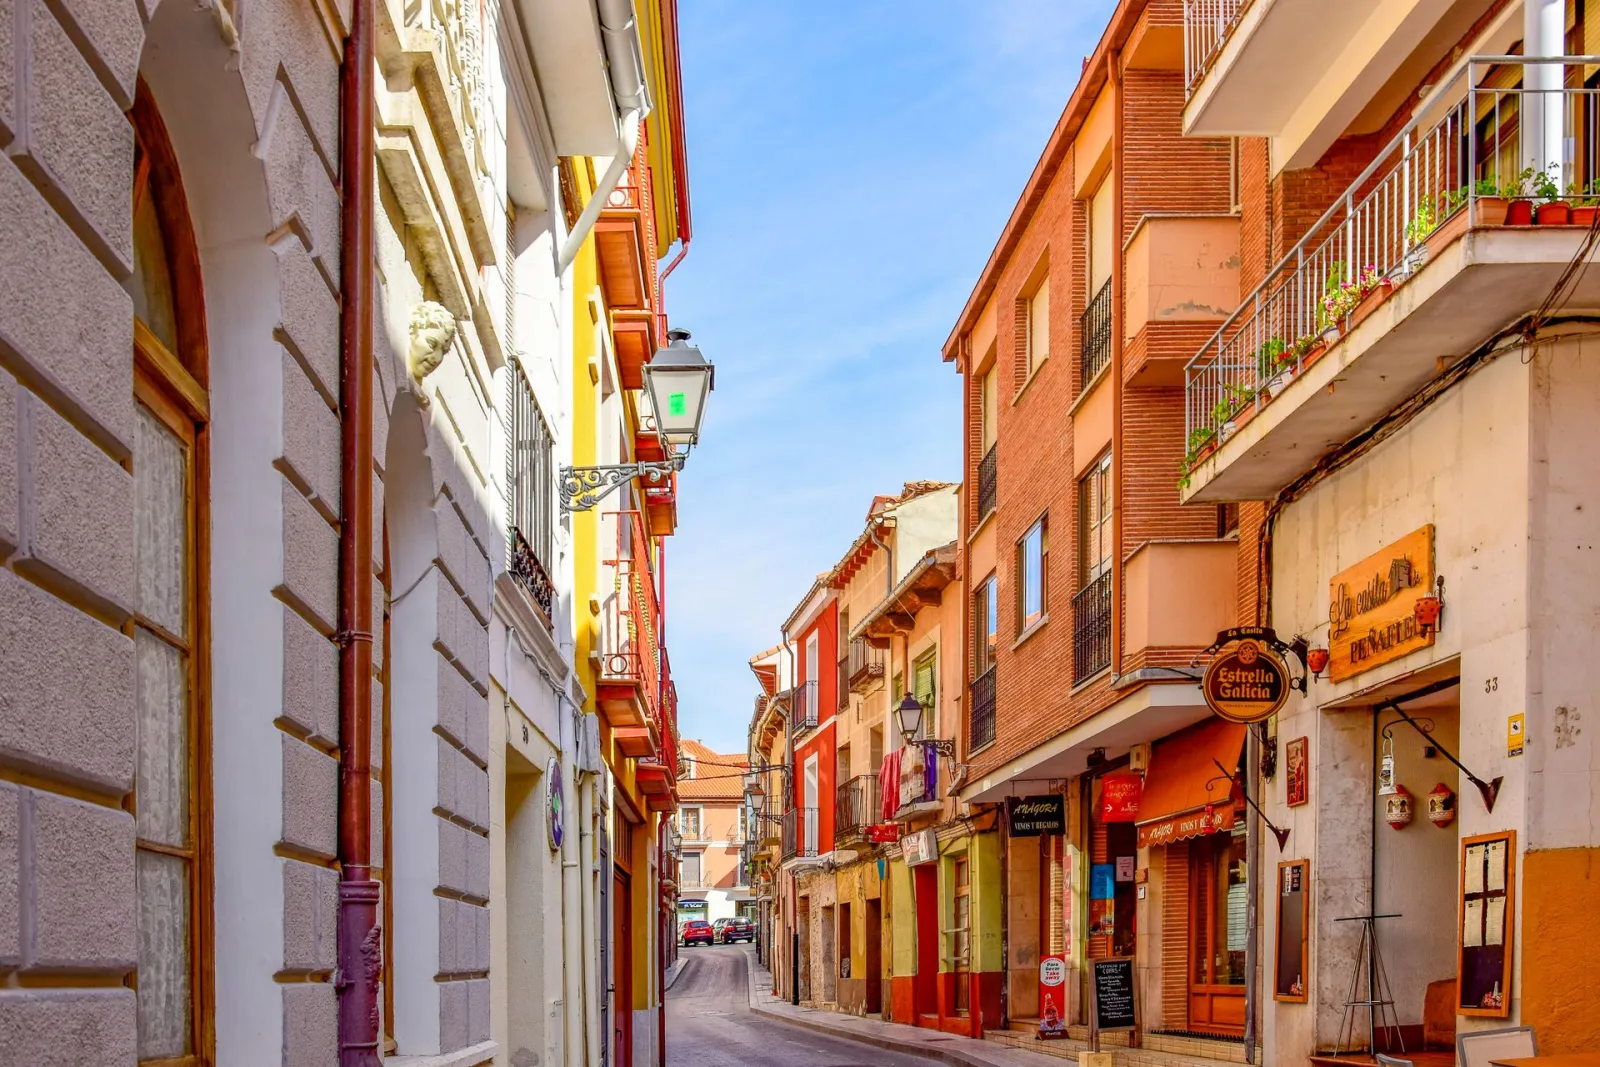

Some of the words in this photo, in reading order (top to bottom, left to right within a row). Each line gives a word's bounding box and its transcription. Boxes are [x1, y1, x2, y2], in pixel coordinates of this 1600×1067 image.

[1329, 583, 1352, 640] La
[1356, 572, 1389, 615] casita
[1227, 629, 1237, 637] La
[1241, 627, 1263, 635] Casita
[1350, 613, 1420, 664] PEÑAFIEL
[1217, 667, 1275, 683] Estrella
[1219, 682, 1271, 699] Galicia
[1485, 676, 1498, 694] 33
[1105, 789, 1138, 799] comercial
[1014, 822, 1031, 830] VINOS
[1036, 821, 1059, 829] REGALOS
[1180, 819, 1194, 833] VINOS
